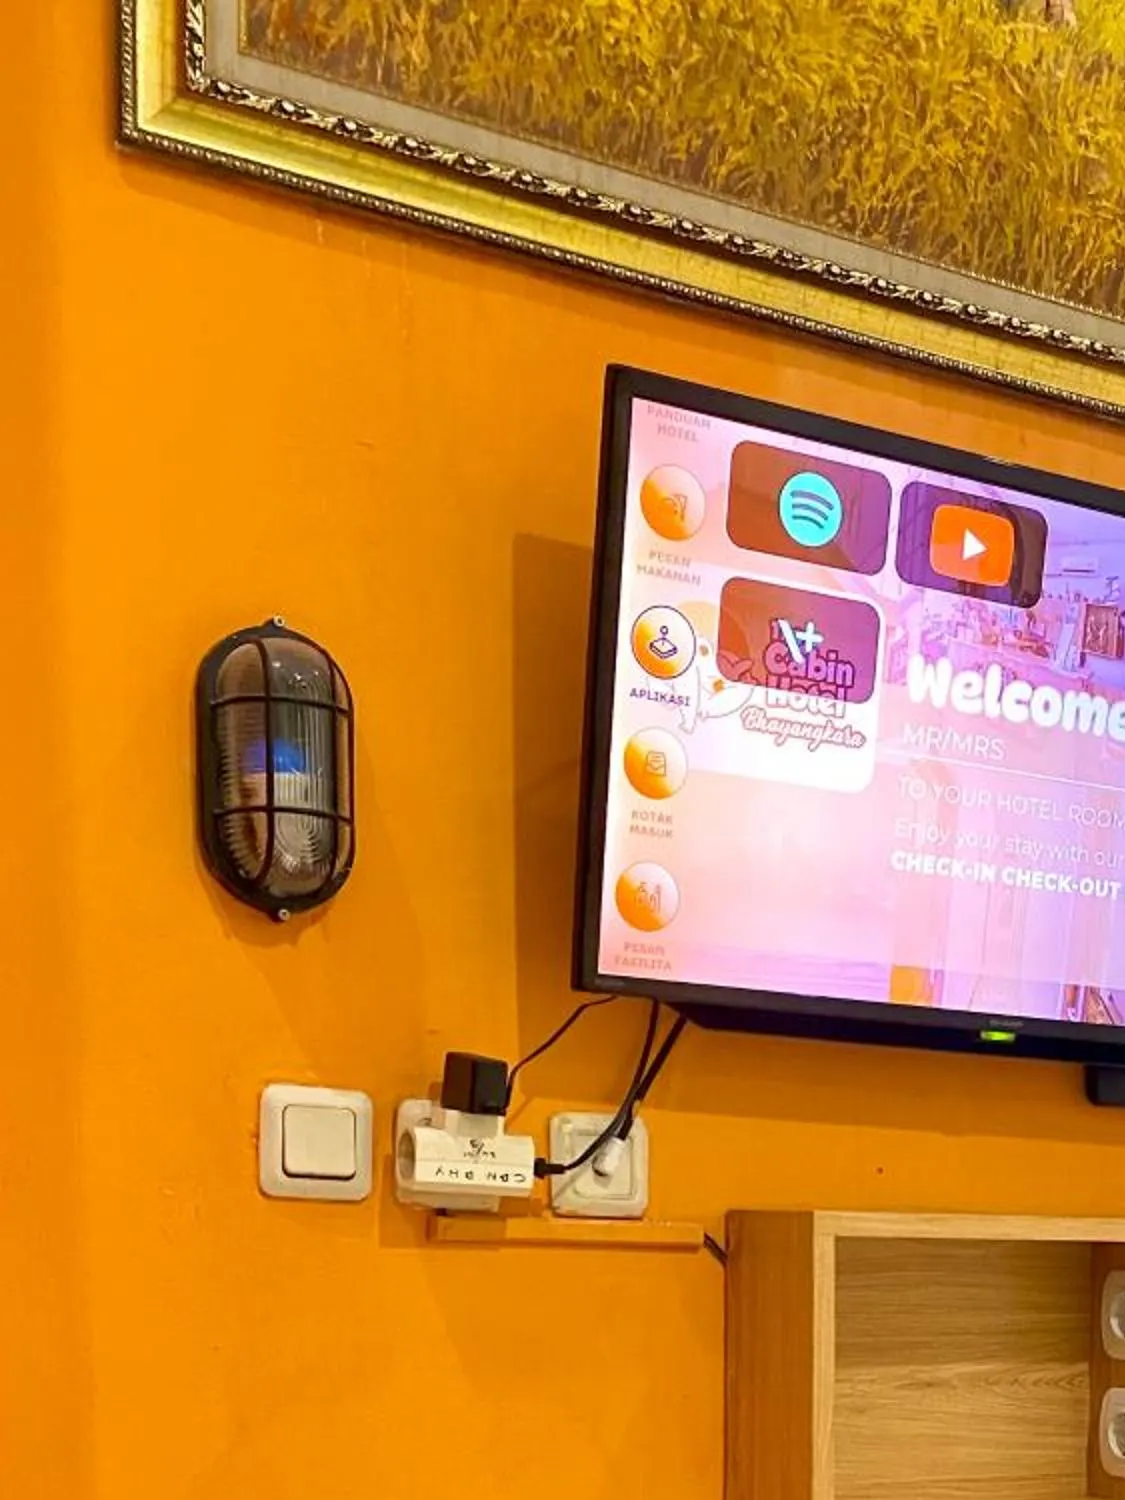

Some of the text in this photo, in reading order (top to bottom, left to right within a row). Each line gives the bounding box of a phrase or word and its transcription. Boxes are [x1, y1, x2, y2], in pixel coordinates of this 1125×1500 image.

[657, 423, 699, 443] HOTEL
[636, 564, 702, 586] MAKANAN
[629, 687, 690, 707] APLIKASI
[902, 723, 1007, 762] MR/MRS
[898, 774, 928, 800] TO
[931, 783, 992, 808] YOUR
[996, 793, 1065, 822] HOTEL
[894, 817, 1125, 870] Enjoy your stay with our
[890, 849, 998, 884] CHECK-IN
[1000, 866, 1122, 901] CHECK-OUT
